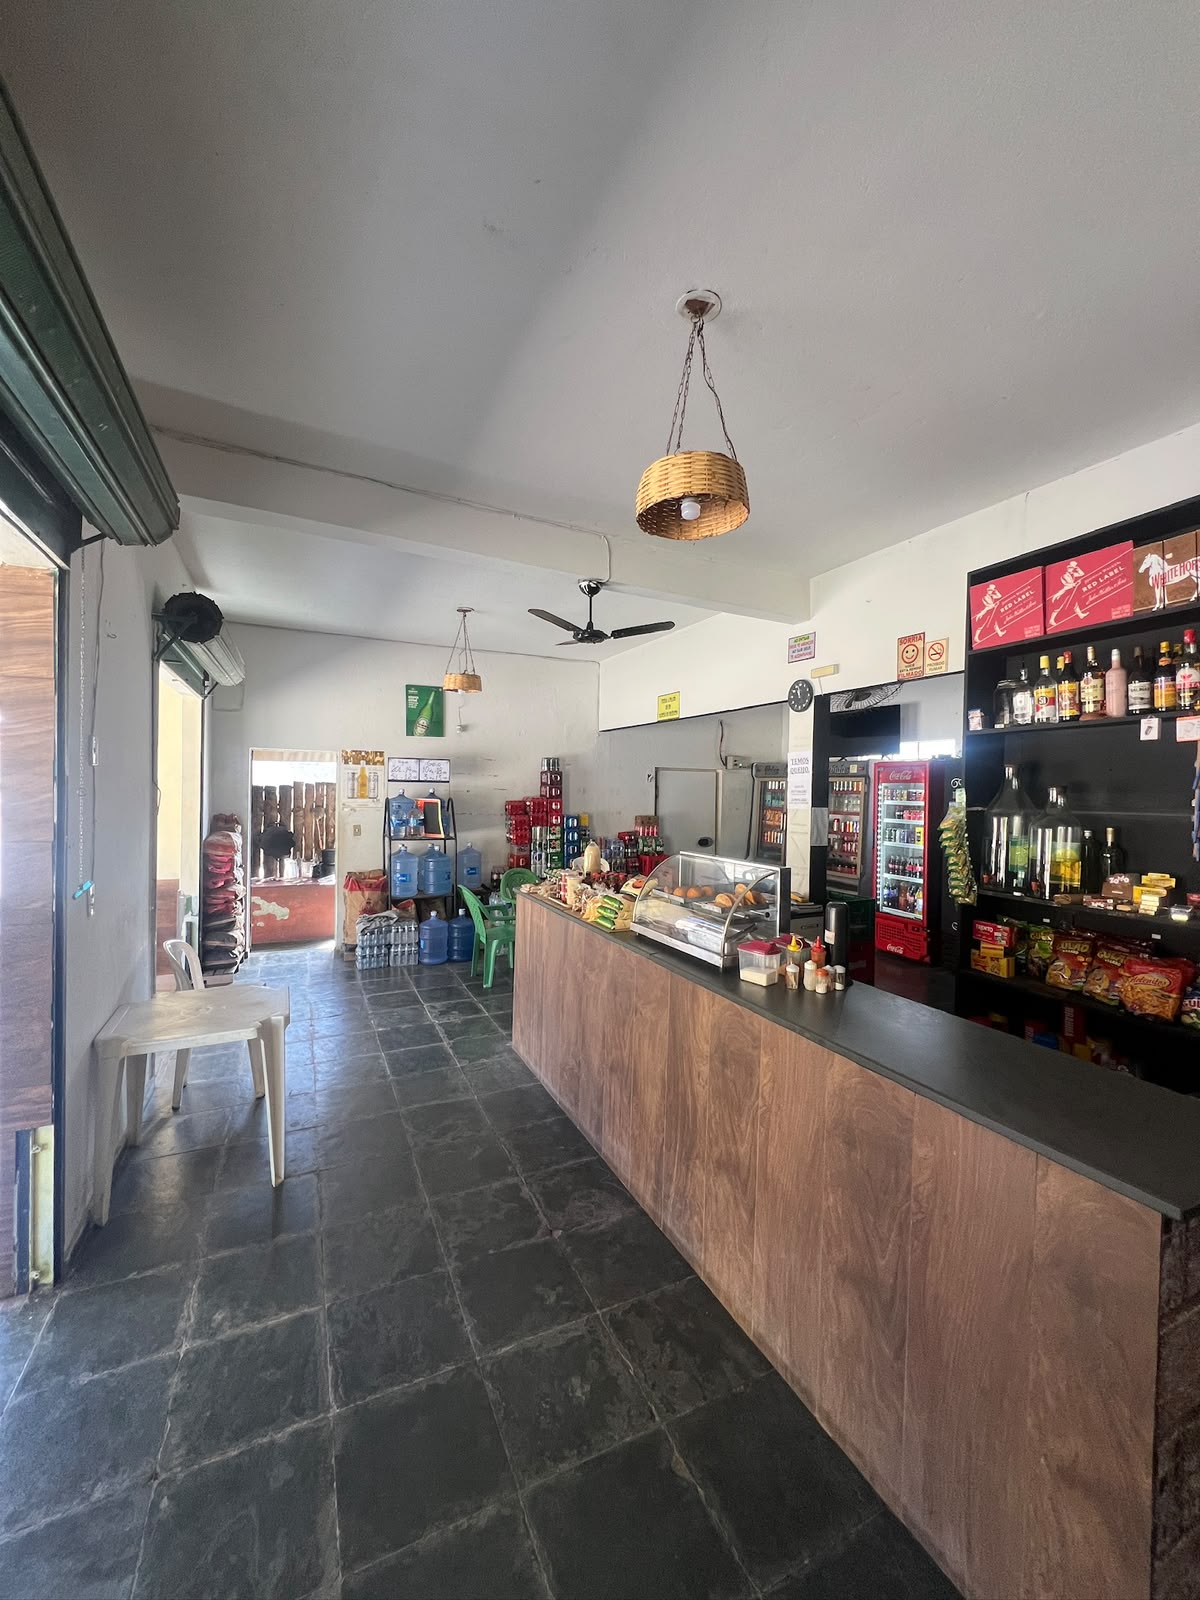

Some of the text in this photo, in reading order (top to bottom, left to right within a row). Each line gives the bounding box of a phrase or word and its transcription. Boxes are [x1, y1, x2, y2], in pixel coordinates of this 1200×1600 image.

[1081, 566, 1125, 593] RED LABEL
[1152, 566, 1178, 590] WHITE
[1000, 602, 1013, 613] RED
[1013, 589, 1035, 605] LABEL
[899, 635, 922, 646] SORRIA
[898, 670, 923, 679] FILMADO
[790, 757, 809, 766] TEMOS
[889, 770, 913, 781] Coca-Cola
[887, 943, 904, 954] Coca-Cola
